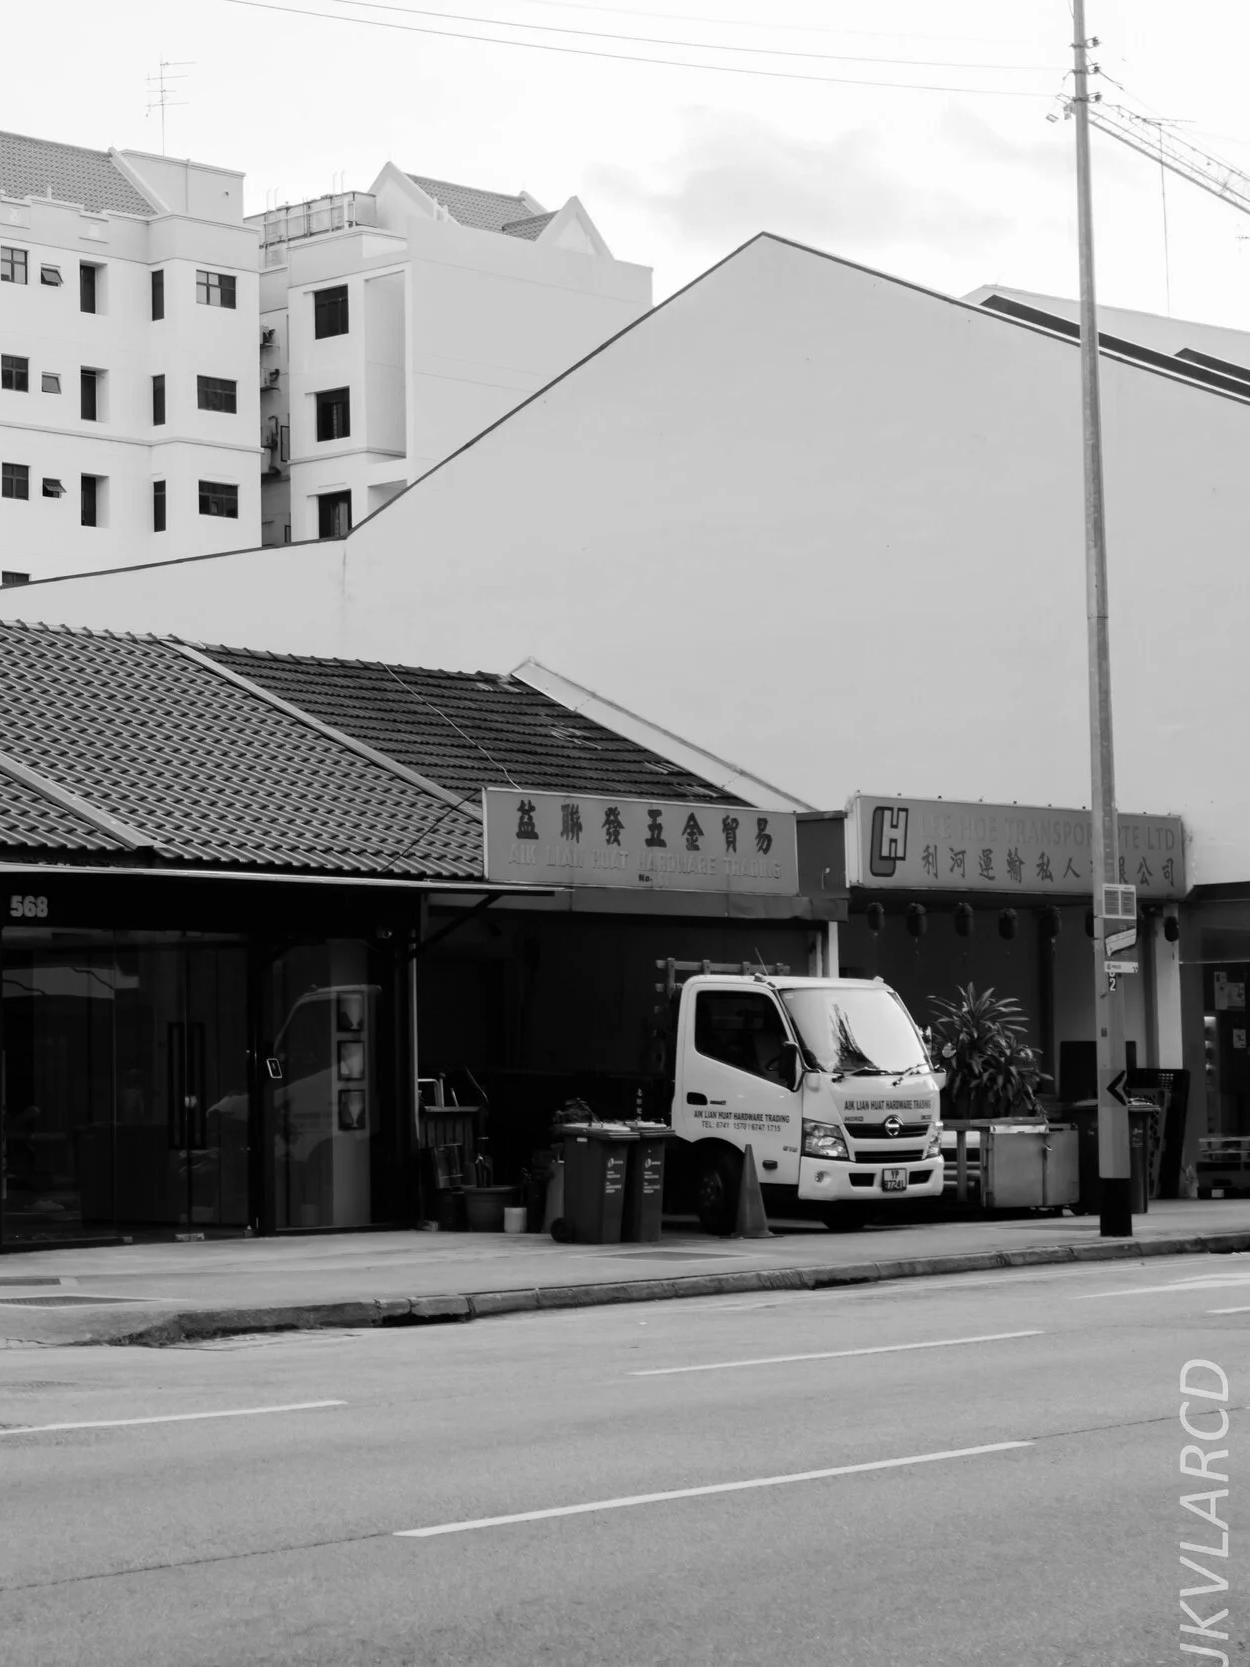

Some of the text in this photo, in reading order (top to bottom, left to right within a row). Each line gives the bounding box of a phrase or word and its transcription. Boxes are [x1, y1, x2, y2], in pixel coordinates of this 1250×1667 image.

[1117, 825, 1140, 850] TE
[1147, 826, 1175, 851] LTD
[508, 843, 782, 880] AIK LIAN HUAT HARDWARE TRADING
[10, 895, 48, 918] 568
[694, 1110, 790, 1123] AIK LIAN HUAT HARDWARE TRADING
[844, 1100, 855, 1111] AIK
[856, 1100, 870, 1111] LIAN
[870, 1100, 885, 1111] HUAT
[885, 1099, 912, 1110] HARDWARE
